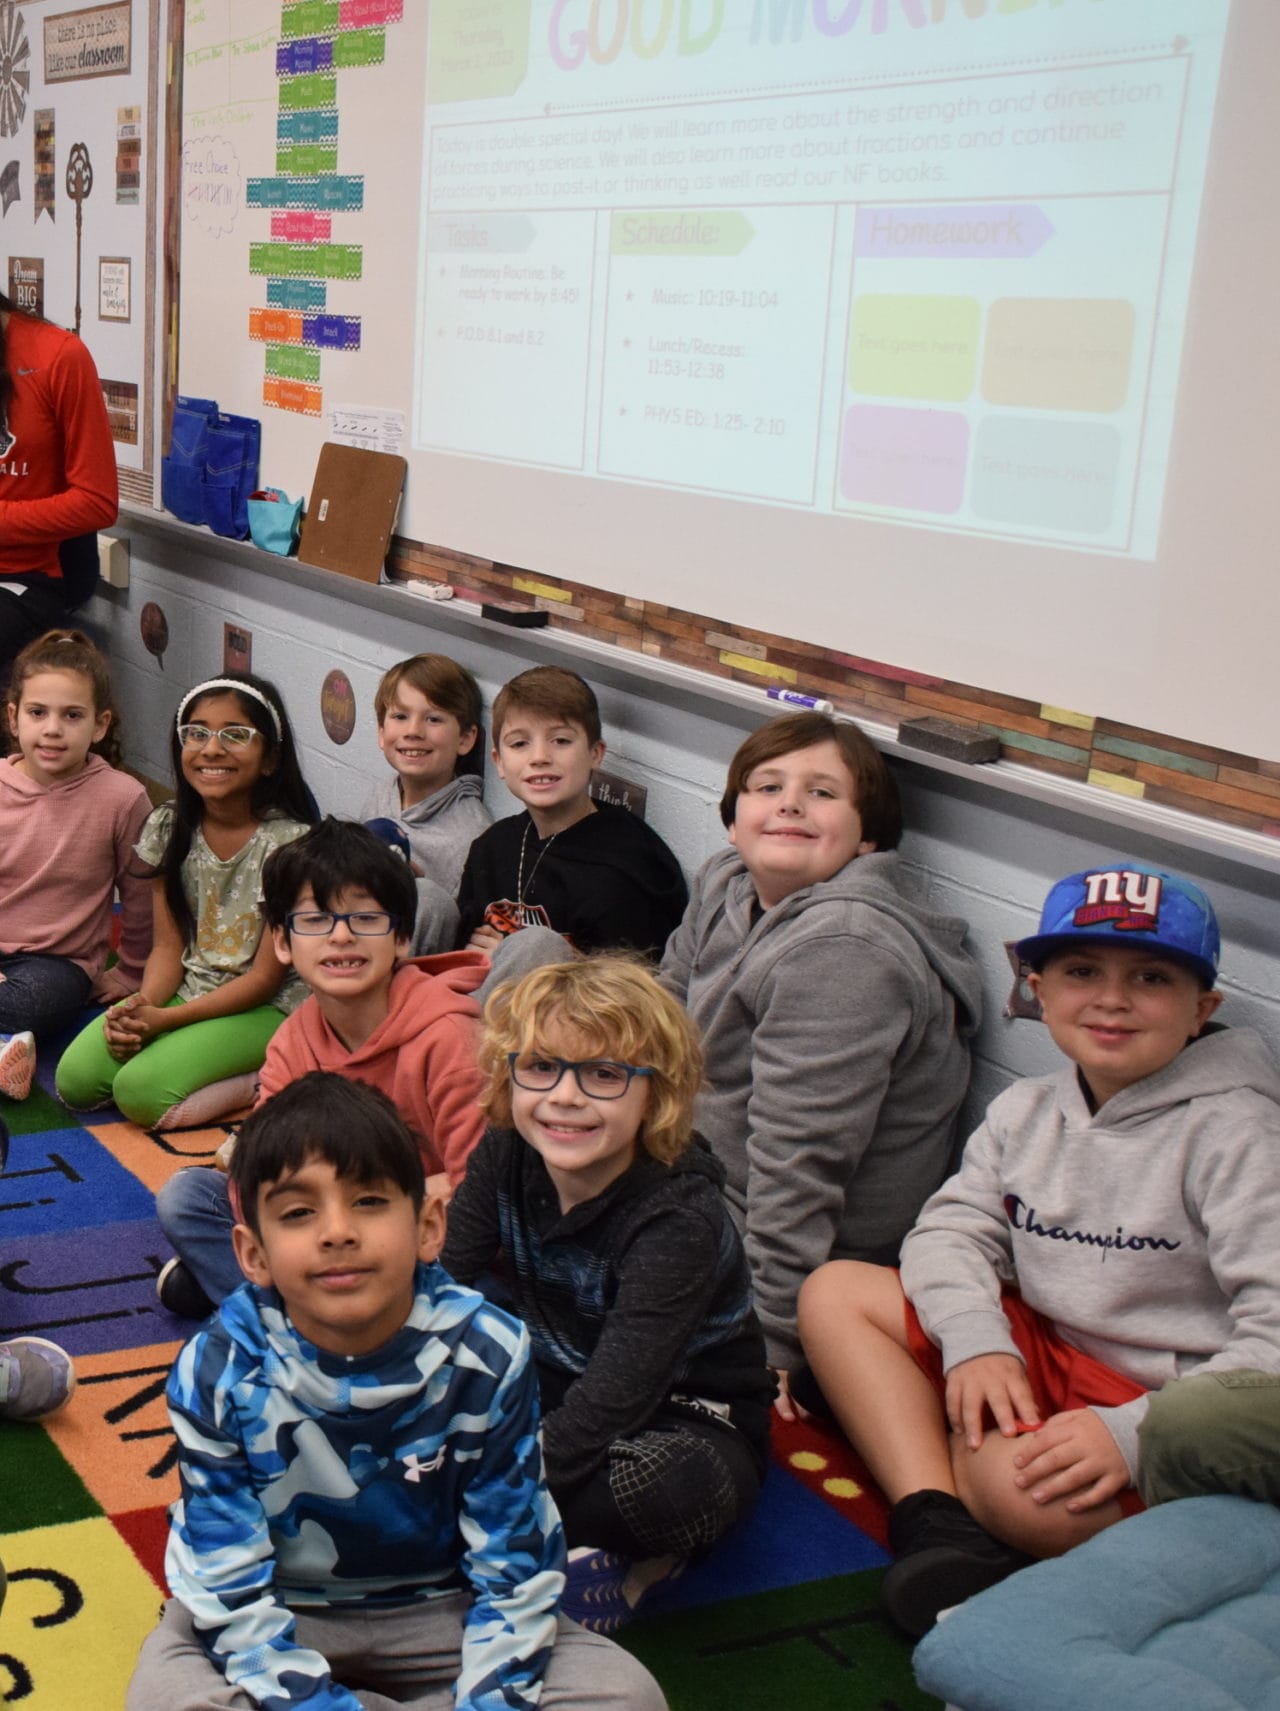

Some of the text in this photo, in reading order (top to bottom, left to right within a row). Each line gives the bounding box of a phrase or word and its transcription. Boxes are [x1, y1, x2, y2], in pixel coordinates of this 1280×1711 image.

[548, 0, 724, 72] GOOD
[78, 42, 125, 68] classroom
[536, 128, 588, 150] special
[683, 117, 726, 137] learn
[731, 115, 778, 133] more
[783, 108, 842, 131] about
[846, 104, 882, 124] the
[886, 95, 981, 125] strength
[988, 88, 1038, 116] and
[1043, 79, 1165, 112] direction
[689, 144, 734, 165] learn
[738, 142, 786, 161] more
[789, 137, 850, 160] about
[855, 130, 953, 156] fractions
[958, 122, 1006, 150] and
[1011, 118, 1128, 148] continue
[623, 174, 690, 197] thinking
[694, 175, 714, 191] as
[718, 169, 751, 190] well
[755, 165, 799, 189] read
[803, 169, 837, 188] our
[842, 162, 871, 186] NF
[870, 209, 1024, 246] Homework
[17, 285, 37, 307] BIG
[647, 357, 726, 381] 11:53-12:38
[1003, 1193, 1181, 1264] Champion
